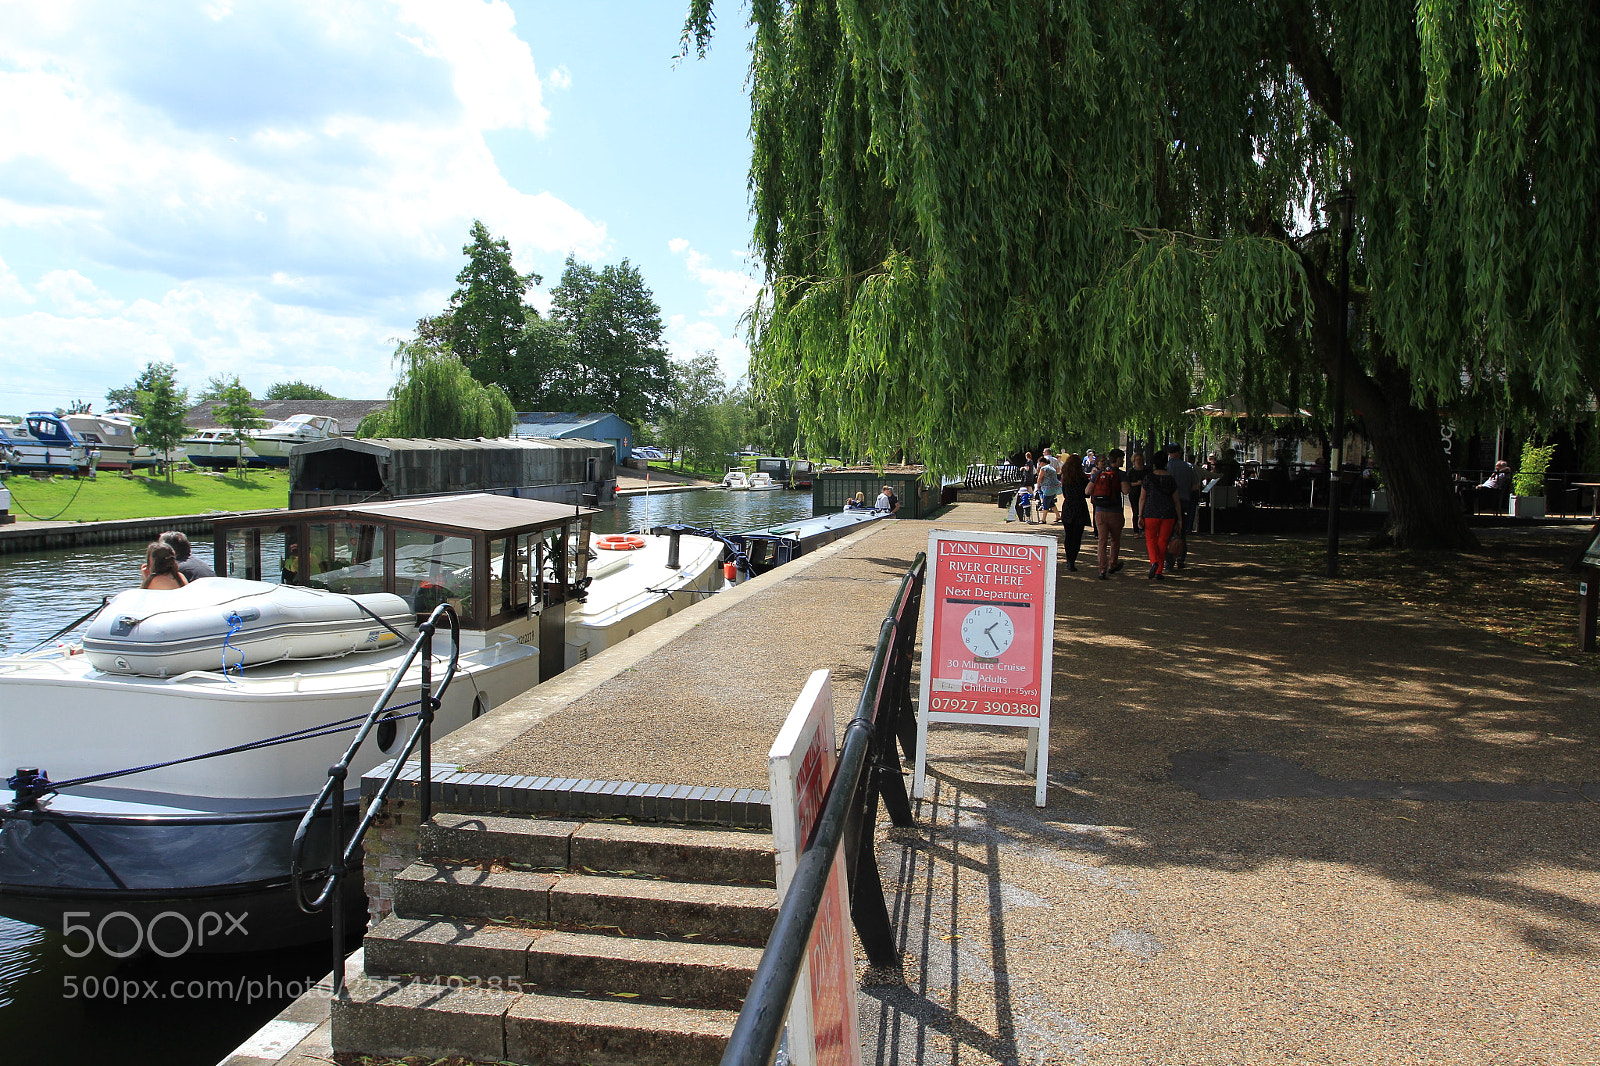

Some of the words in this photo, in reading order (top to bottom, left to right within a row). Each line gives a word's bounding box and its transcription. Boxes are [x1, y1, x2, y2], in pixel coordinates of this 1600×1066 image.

[940, 542, 979, 556] LYNN
[989, 545, 1043, 561] UNION
[949, 561, 981, 572] RIVER
[984, 563, 1032, 575] CRUISES
[956, 573, 991, 584] START
[994, 575, 1024, 586] HERE
[945, 586, 971, 597] Next
[974, 588, 1034, 601] Departure:
[947, 660, 959, 668] 30
[962, 660, 994, 670] Minute
[997, 662, 1026, 672] Cruise
[979, 674, 1008, 684] Adults
[963, 683, 1001, 693] Children
[931, 697, 978, 712] 07927
[983, 701, 1039, 715] 390380
